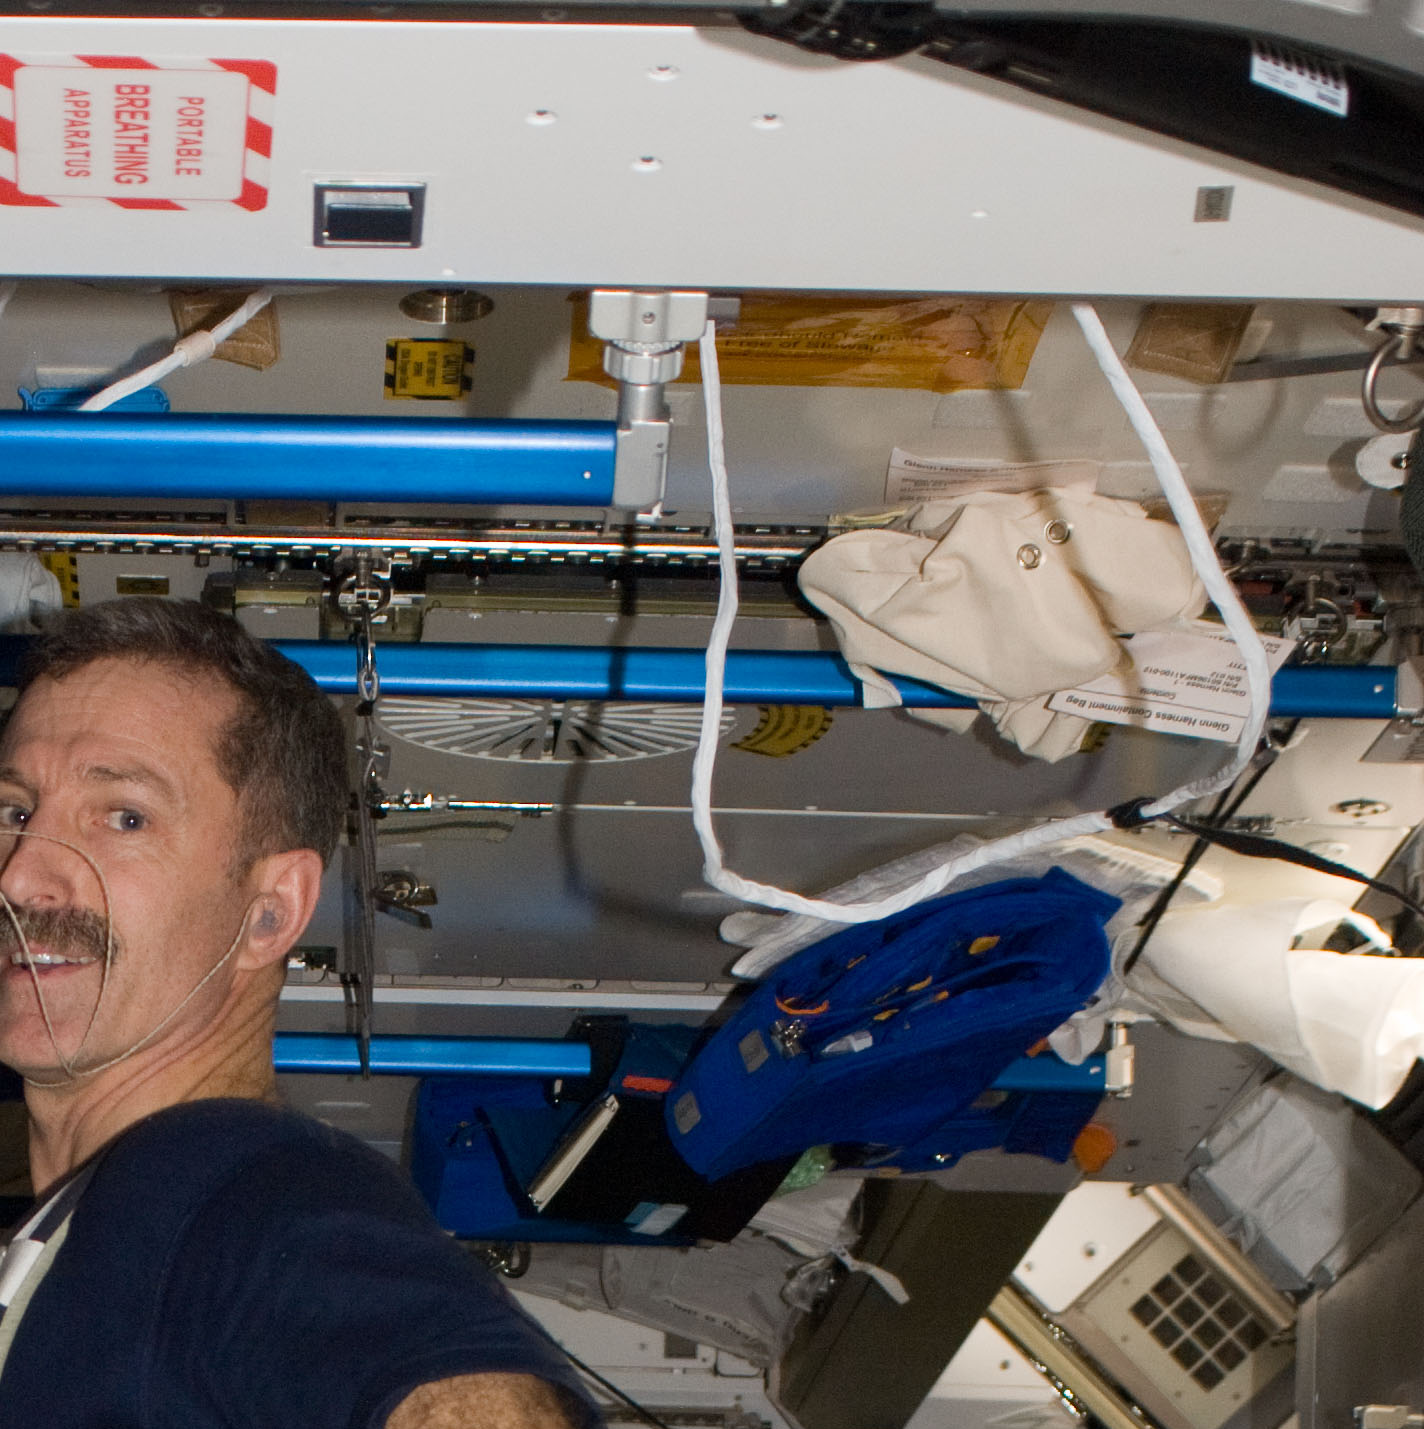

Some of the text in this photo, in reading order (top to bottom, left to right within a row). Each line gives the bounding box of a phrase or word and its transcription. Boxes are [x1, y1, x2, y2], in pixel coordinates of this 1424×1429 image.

[63, 87, 92, 179] APPARATUS
[113, 83, 152, 186] BREATHING
[174, 96, 205, 177] PORTABLE
[1065, 694, 1231, 733] Glenn Harness Containment Bag
[1185, 681, 1221, 694] Harness
[1221, 687, 1247, 698] Glenn
